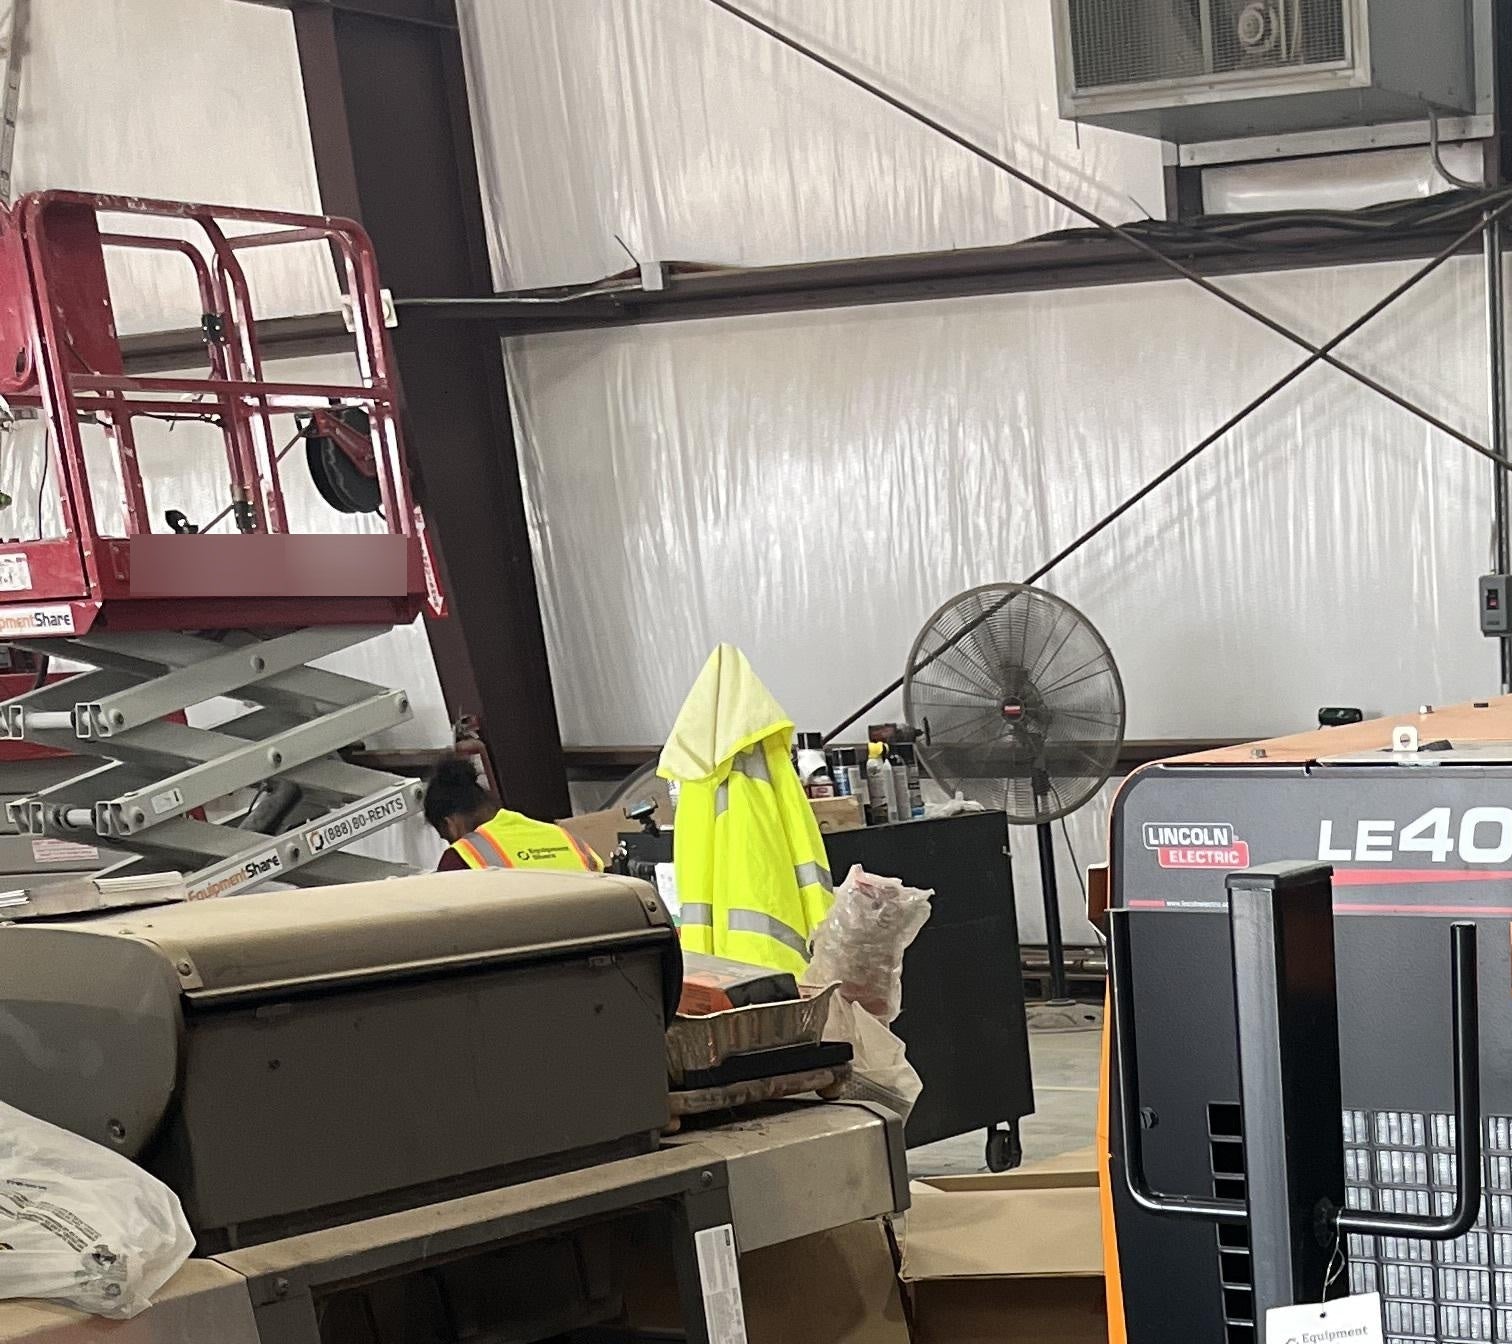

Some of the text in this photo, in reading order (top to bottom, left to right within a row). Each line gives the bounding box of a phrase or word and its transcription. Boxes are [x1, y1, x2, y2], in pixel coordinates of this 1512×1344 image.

[323, 797, 404, 844] (888) 80-RENTS
[1148, 827, 1228, 846] LINCOLN
[1168, 850, 1240, 864] ELECTRIC
[1302, 1325, 1369, 1344] Equipment
